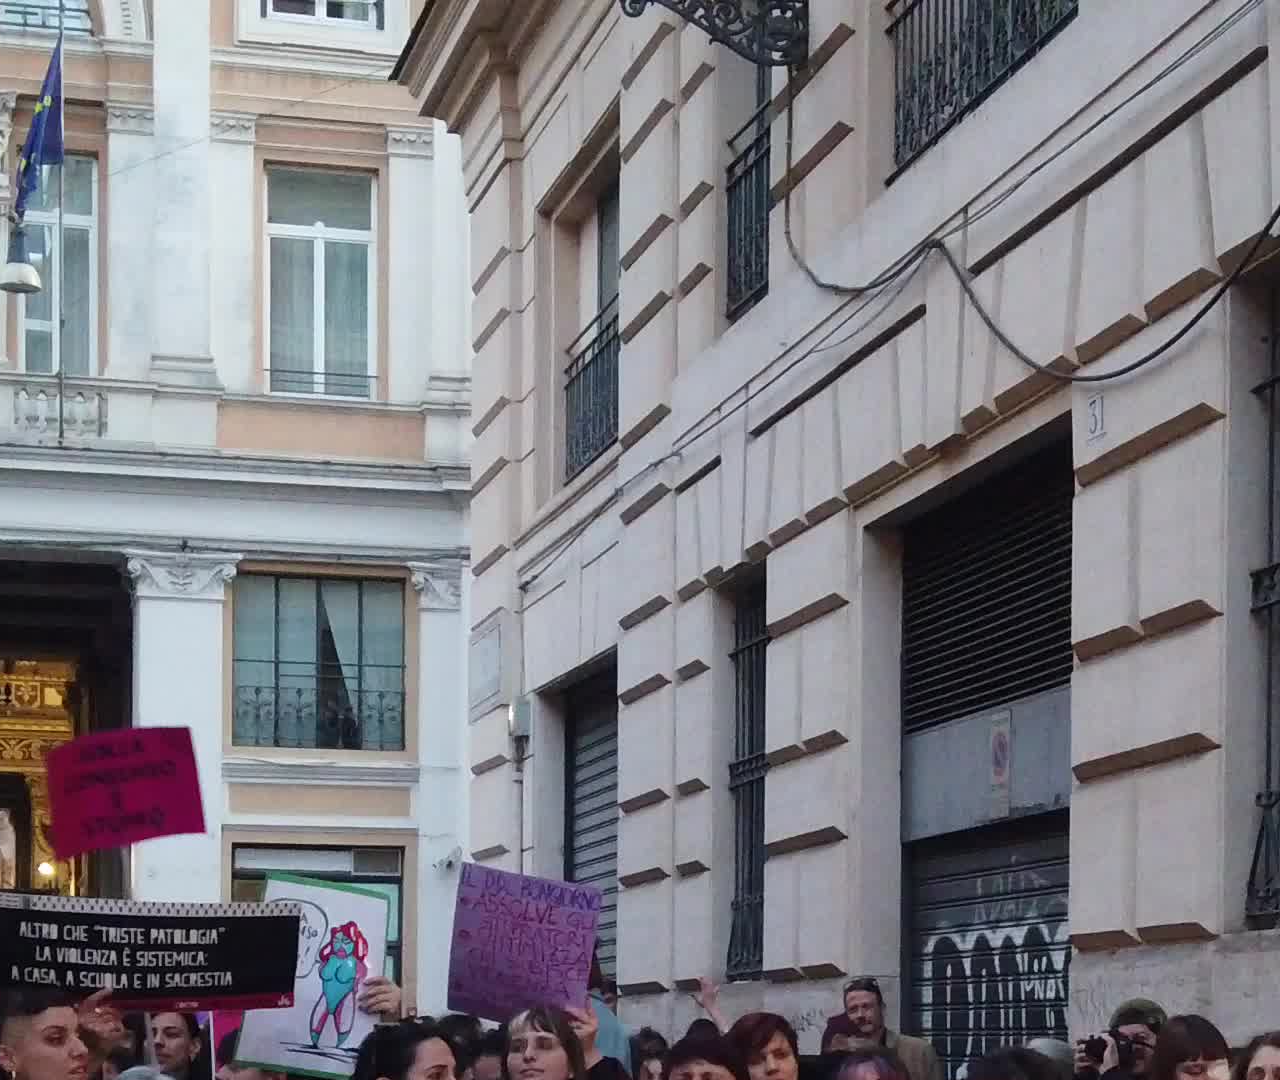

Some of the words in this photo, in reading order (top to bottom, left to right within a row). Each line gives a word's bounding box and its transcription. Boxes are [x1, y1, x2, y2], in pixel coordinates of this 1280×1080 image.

[19, 920, 58, 940] ALTRO
[63, 924, 89, 942] CHE
[35, 945, 52, 962] LA
[56, 946, 118, 966] VIOLENZA
[122, 946, 131, 967] È
[10, 964, 20, 981] A
[65, 969, 75, 986] A
[79, 970, 129, 989] SCUOLA
[133, 972, 142, 989] E
[146, 972, 160, 988] IN
[165, 970, 233, 988] SACRESTIA
